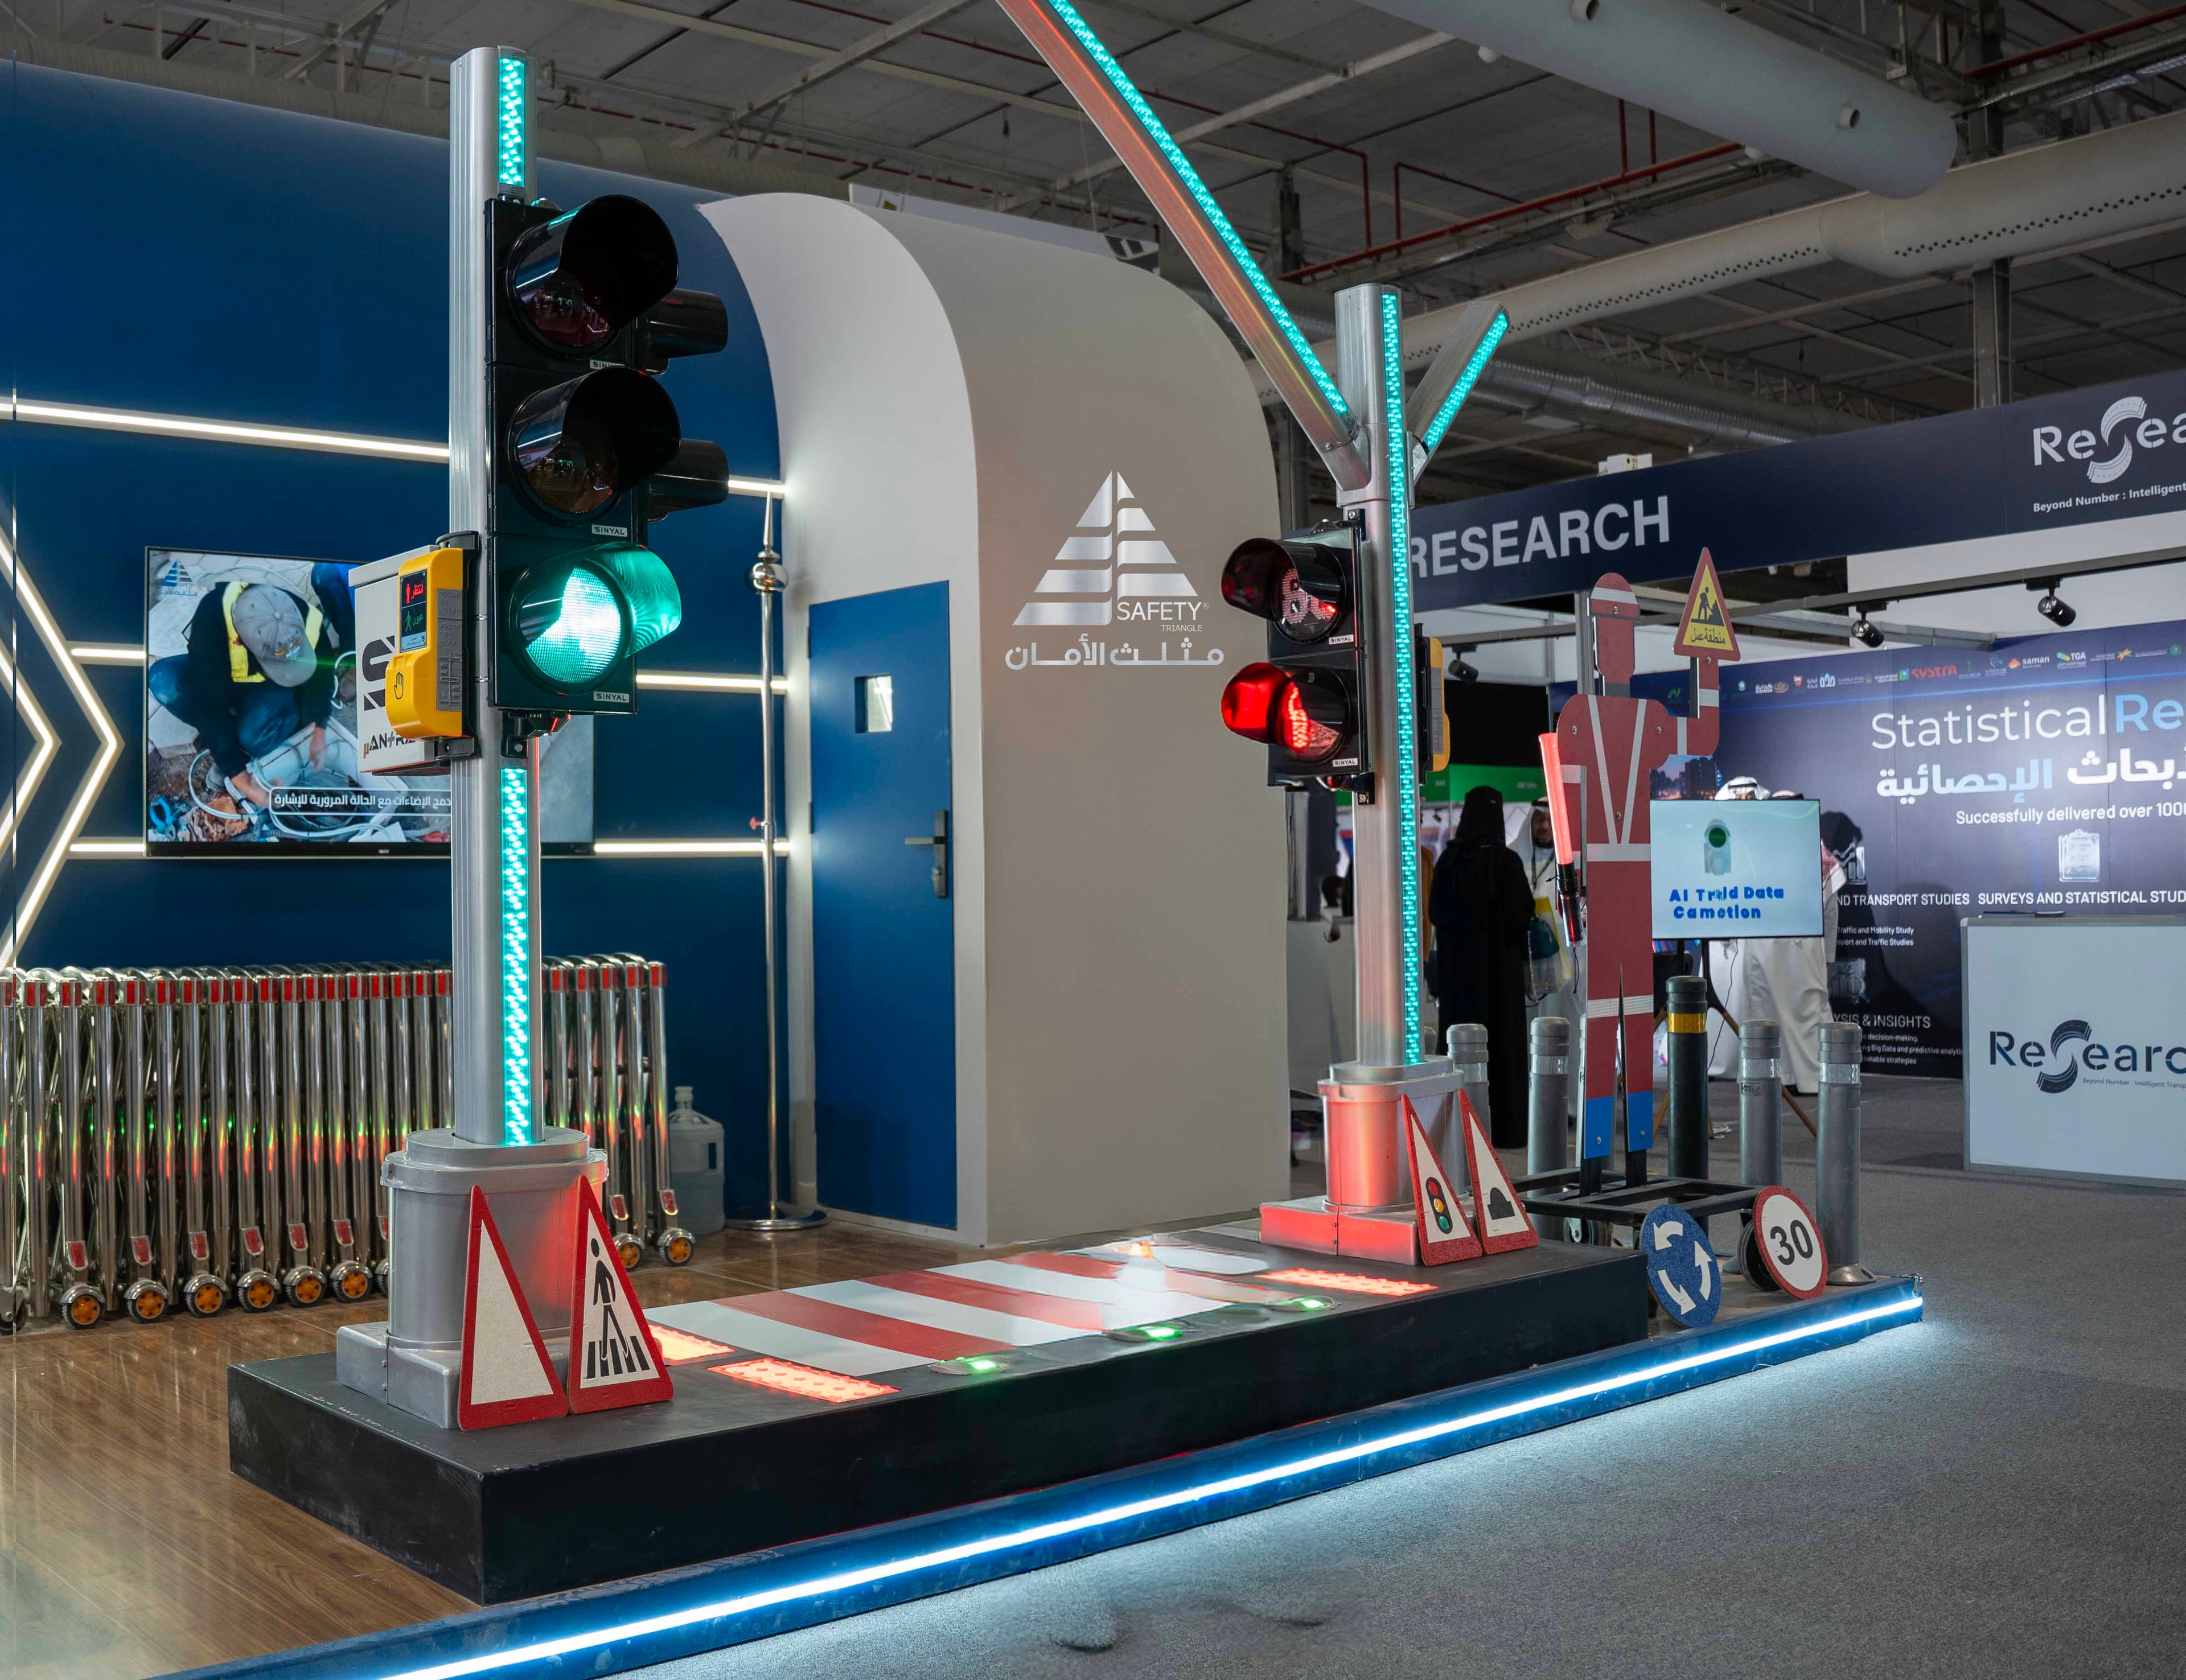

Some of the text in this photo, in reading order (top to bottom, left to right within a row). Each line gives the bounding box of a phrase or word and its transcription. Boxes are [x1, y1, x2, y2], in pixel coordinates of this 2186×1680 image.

[2033, 499, 2072, 513] Beyond
[2076, 492, 2119, 506] Number
[2129, 482, 2186, 499] Intelligent
[594, 526, 624, 535] SINYAL
[1411, 495, 1669, 578] RESEARCH
[1691, 628, 1725, 644] منطقة عمل
[1005, 633, 1224, 670] مثلث الأمان
[2070, 652, 2086, 661] TGA
[2022, 656, 2050, 665] saman
[1876, 743, 2186, 804] بحاث الإحصائية
[274, 793, 307, 808] للإشارة
[309, 794, 348, 808] المرورية
[350, 795, 376, 805] الحالة
[377, 798, 392, 808] مع
[393, 796, 431, 808] الإضاءات
[1956, 808, 2043, 825] Successfully
[2047, 804, 2115, 822] delivered
[2119, 806, 2153, 818] over
[1744, 887, 1784, 899] Data
[1853, 893, 1918, 906] TRANSPORT
[1921, 893, 1970, 905] STUDIES
[1978, 892, 2034, 905] SURVEYS
[2036, 892, 2063, 904] AND
[2065, 891, 2147, 904] STATISTICAL
[1871, 927, 1895, 936] Mobility
[1896, 926, 1914, 935] Study
[1862, 1014, 1871, 1027] &
[1874, 1015, 1931, 1029] INSIGHTS
[1871, 1045, 1881, 1053] Big
[2135, 1080, 2164, 1089] Intelligent
[1770, 1220, 1813, 1266] 30
